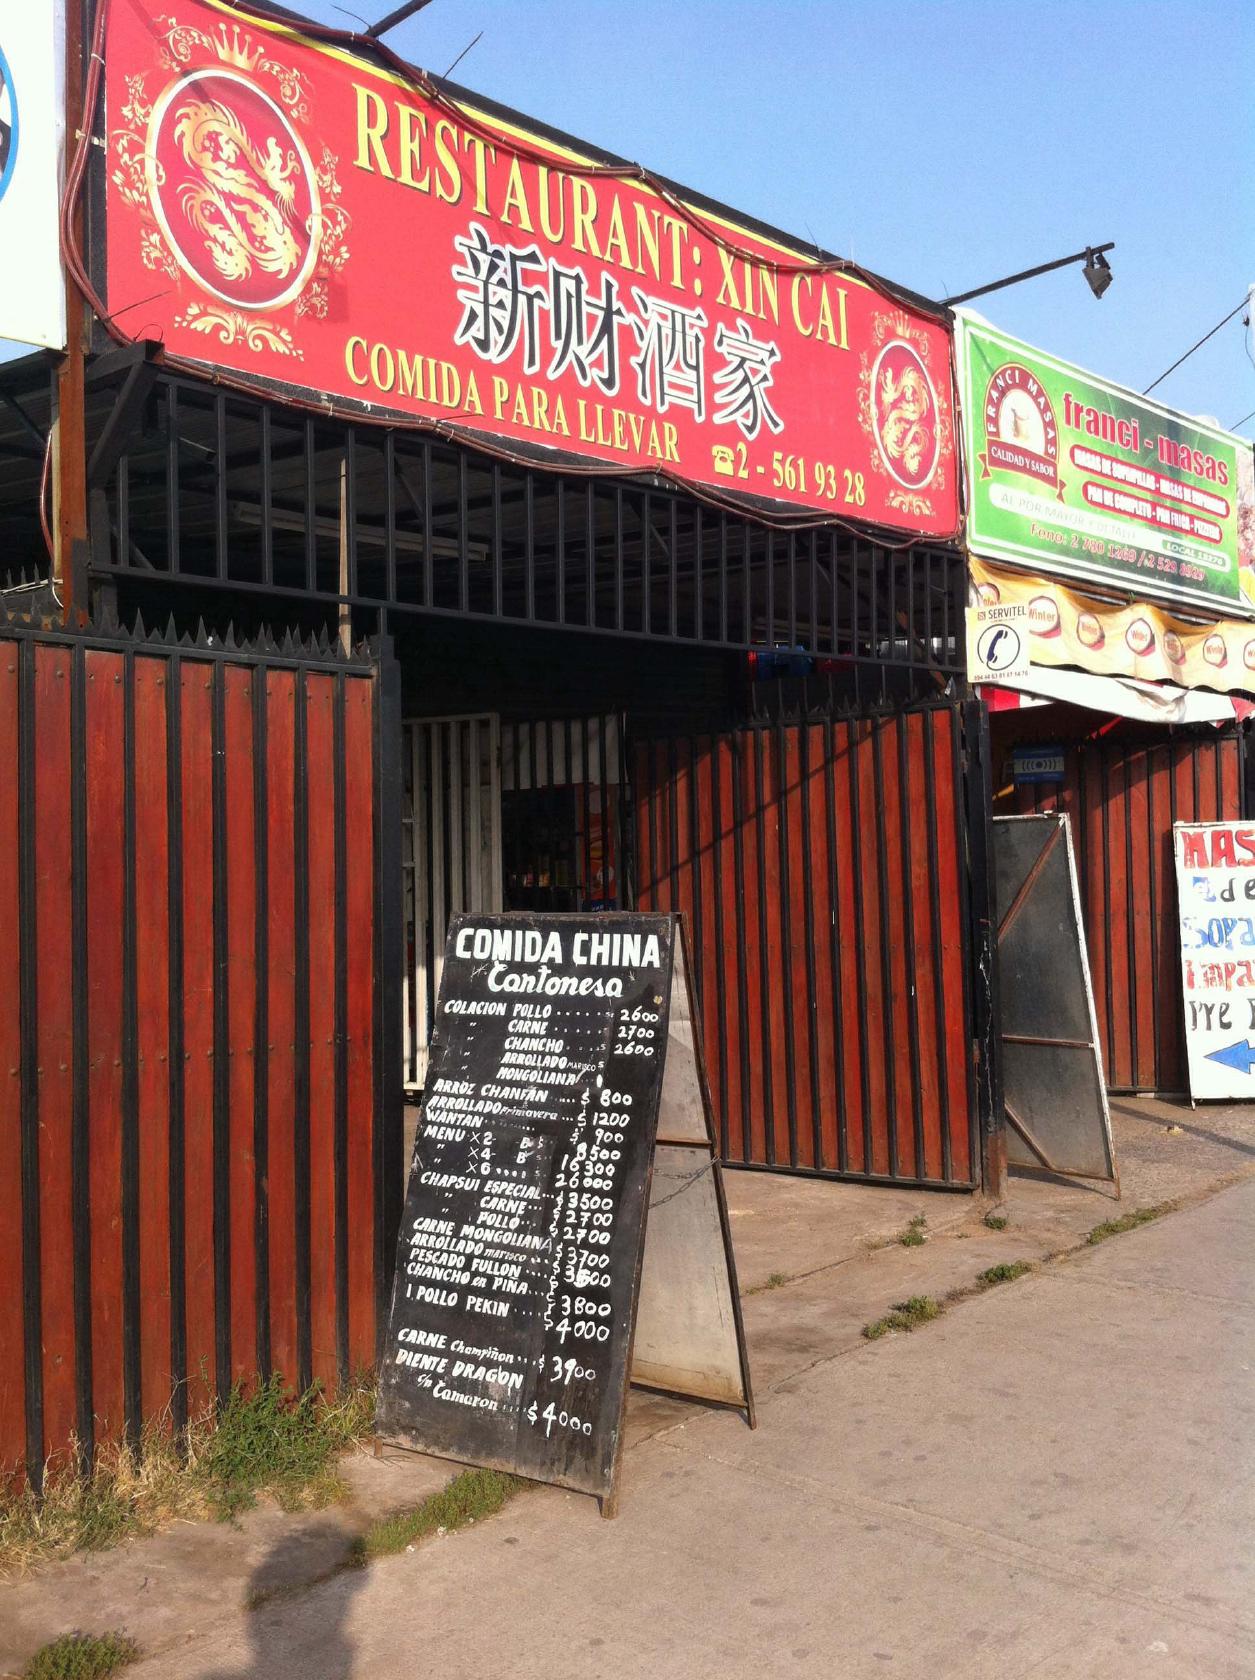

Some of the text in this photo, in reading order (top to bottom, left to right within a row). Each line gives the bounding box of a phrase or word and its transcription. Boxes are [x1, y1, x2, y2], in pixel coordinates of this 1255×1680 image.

[352, 82, 851, 351] RESTAURANT: XIN CAI
[450, 222, 784, 441] 新财酒家
[344, 335, 682, 464] COMIDA PARA LLEVAR
[987, 369, 1056, 456] FRANCI MASAS
[1062, 391, 1140, 454] franci
[1158, 434, 1229, 486] masas
[736, 441, 749, 480] 2
[772, 451, 808, 494] 561
[814, 461, 837, 500] 93
[843, 468, 866, 507] 28
[991, 446, 1024, 467] CALIDAD
[1031, 461, 1055, 478] SABOR
[988, 605, 1027, 619] SERVITEL
[455, 928, 661, 968] COMIDA CHINA
[487, 960, 624, 998] Cantonesa
[444, 999, 507, 1016] COLACION
[512, 1003, 552, 1019] POLLO
[620, 1005, 659, 1022] 2600
[504, 1036, 564, 1054] CHANCHO
[614, 1041, 655, 1057] 2600
[508, 1019, 655, 1041] CARNE 2700
[495, 1066, 578, 1087] MONGOLIANA
[500, 1051, 568, 1070] ARROLLADO
[427, 1095, 503, 1115] ARROLLADO
[592, 1111, 630, 1128] 1200
[433, 1078, 476, 1096] ARROZ
[480, 1083, 549, 1103] CHANFAN
[600, 1088, 633, 1107] 800
[423, 1124, 466, 1142] MENU
[426, 1108, 484, 1128] WANTAN
[594, 1128, 624, 1146] 900
[420, 1171, 481, 1191] CHAPSUI
[483, 1180, 542, 1200] ESPECIAL
[568, 1191, 613, 1211] 3500
[476, 1211, 520, 1230] POLLO
[563, 1226, 611, 1245] 2700
[480, 1196, 528, 1215] CARNE
[566, 1209, 613, 1227] 2700
[409, 1232, 484, 1256] ARROLLADO
[409, 1247, 466, 1269] PESCADO
[412, 1216, 455, 1236] CARNE
[459, 1224, 553, 1254] MONGOLIANA
[567, 1246, 610, 1269] 3700
[406, 1261, 471, 1285] CHANCHO
[471, 1276, 488, 1289] en
[492, 1275, 529, 1296] PIÑA
[561, 1294, 612, 1317] 3800
[416, 1284, 458, 1307] POLLO
[466, 1295, 510, 1318] PEKIN
[555, 1317, 610, 1344] 4000
[395, 1348, 524, 1391] DIENTE DRAGON
[397, 1327, 448, 1349] CARNE
[550, 1355, 597, 1385] 3900
[432, 1379, 499, 1412] Camaron
[527, 1399, 538, 1426] $
[542, 1401, 593, 1438] 4000
